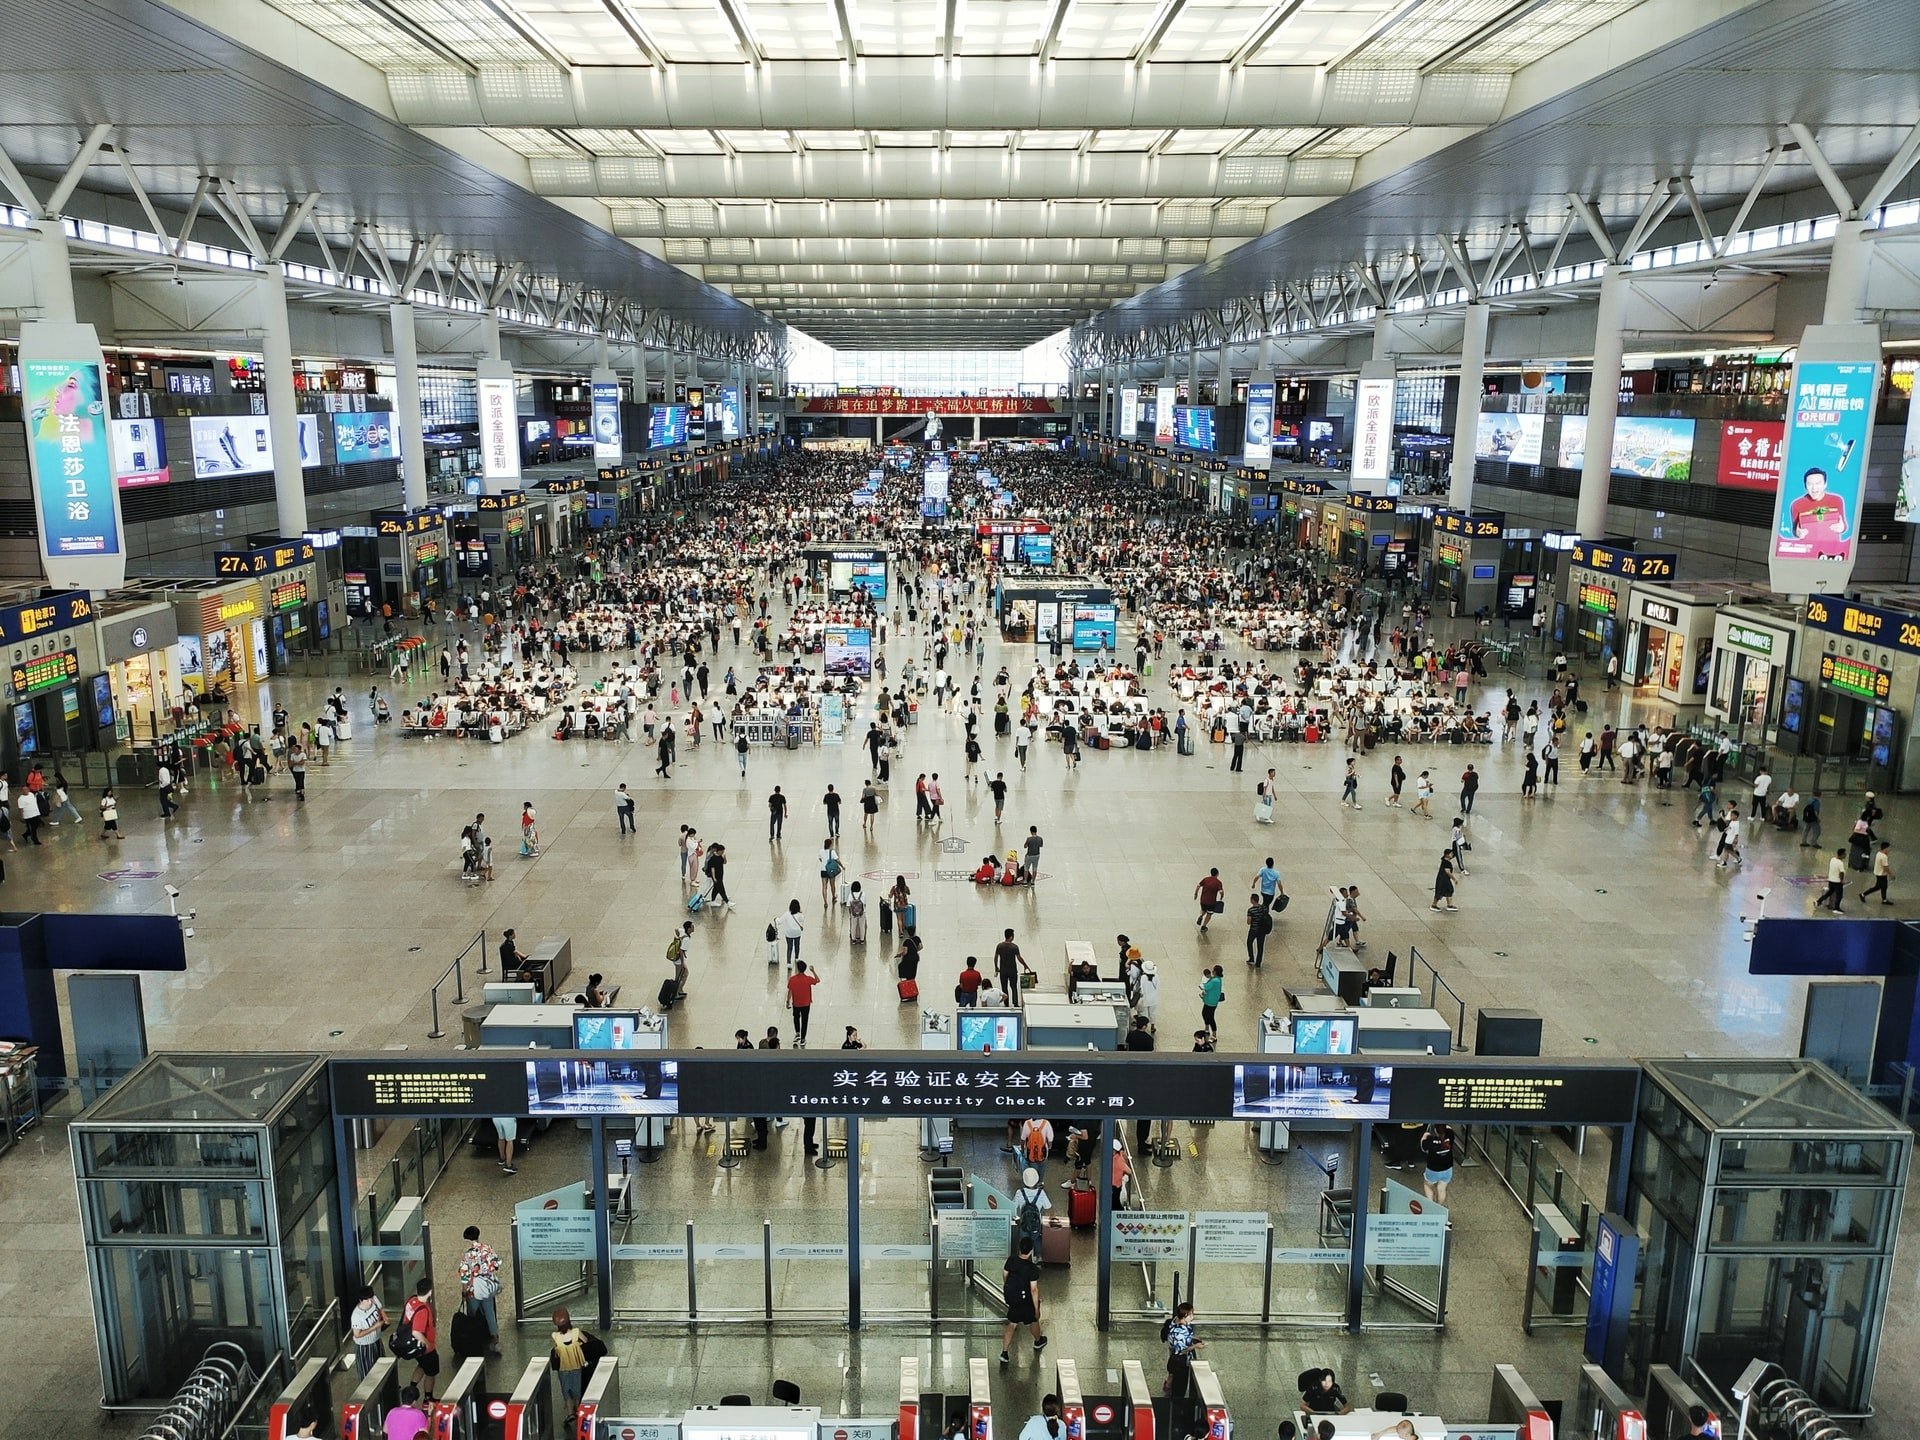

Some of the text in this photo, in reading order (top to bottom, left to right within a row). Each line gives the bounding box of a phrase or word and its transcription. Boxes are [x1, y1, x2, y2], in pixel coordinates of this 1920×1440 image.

[823, 399, 924, 412] 奔跑在追梦路上
[932, 399, 1033, 412] 幸福从虹桥出发
[490, 394, 507, 469] 欧派全屋定制
[1363, 394, 1381, 470] 欧派全屋定制
[58, 413, 90, 521] 法恩莎卫浴
[549, 483, 564, 491] 21A
[480, 499, 498, 509] 23A
[380, 521, 402, 533] 25A
[1477, 523, 1499, 535] 25B
[220, 556, 267, 572] 27A 27A
[833, 552, 874, 562] TONYMOLY
[1622, 557, 1670, 575] 27B 27B
[34, 606, 56, 621] 检票口
[71, 599, 91, 619] 28A
[1807, 601, 1828, 623] 28B
[1857, 613, 1882, 629] 检票口
[833, 1070, 1094, 1089] 实名验证&安全检查
[790, 1095, 871, 1106] Identity
[882, 1096, 891, 1105] &
[903, 1095, 984, 1107] Security
[995, 1096, 1046, 1106] Check
[640, 1429, 659, 1438] 关闭
[853, 1430, 872, 1439] 关闭
